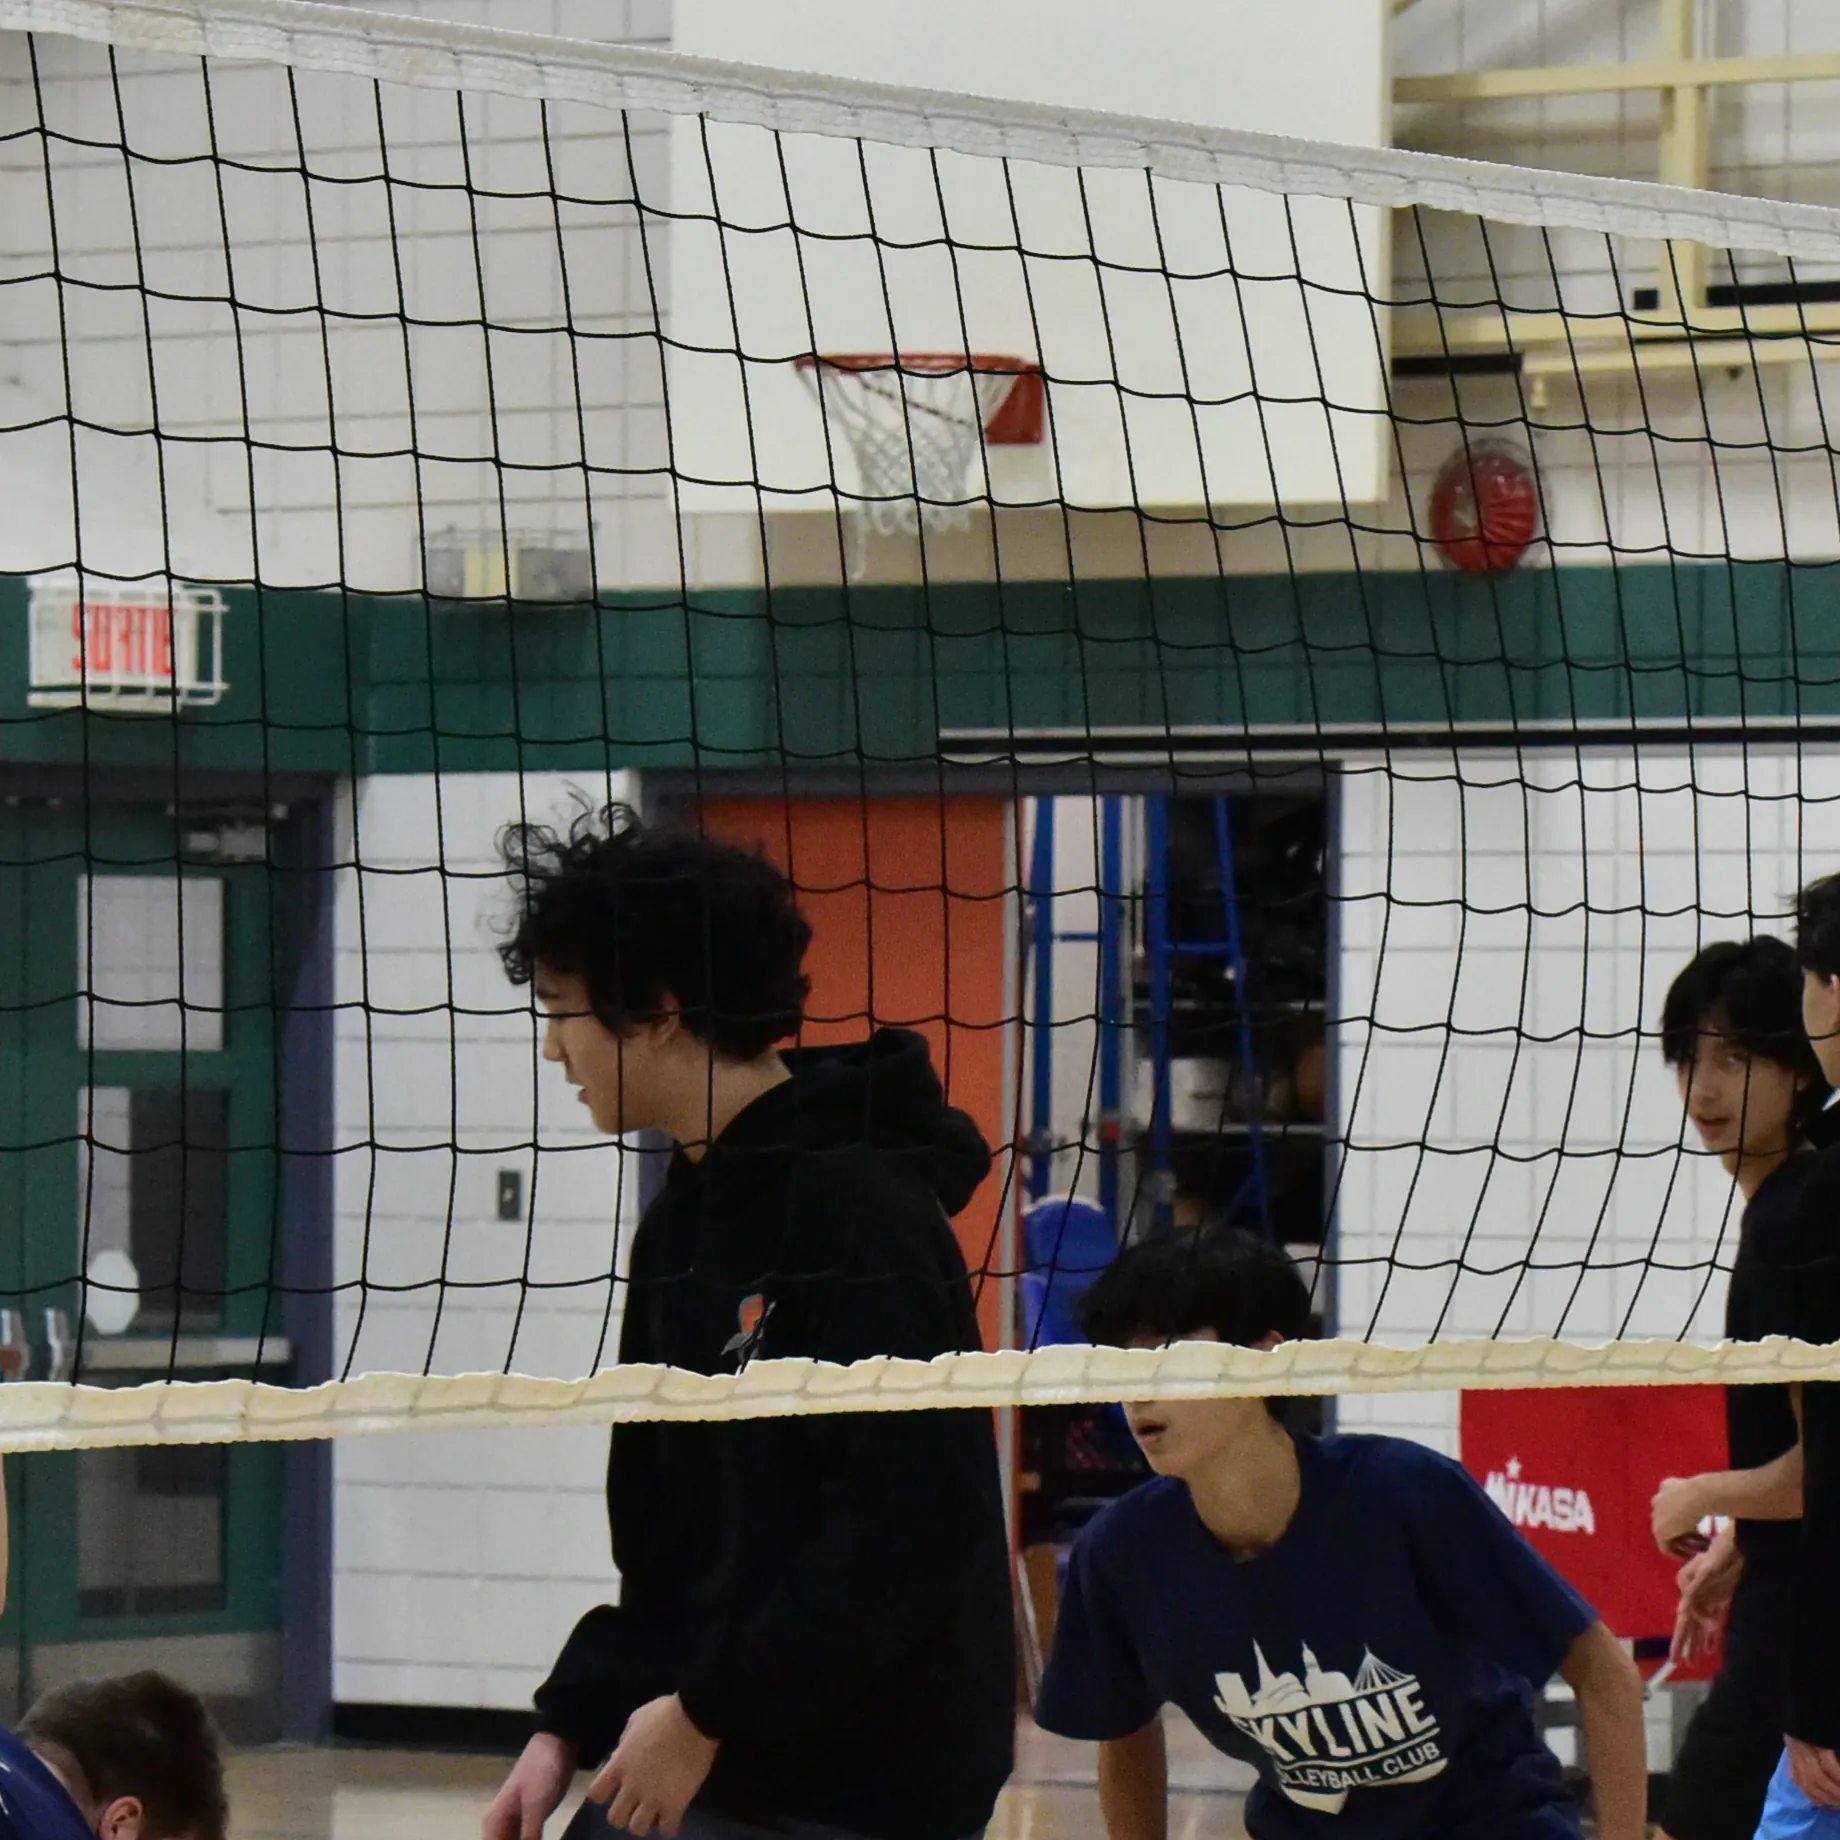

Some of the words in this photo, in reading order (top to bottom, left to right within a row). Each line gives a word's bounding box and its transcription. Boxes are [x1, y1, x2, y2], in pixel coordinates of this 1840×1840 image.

[1232, 1681, 1437, 1762] KYLINE
[1280, 1764, 1382, 1790] LLEYBALL
[1382, 1741, 1441, 1776] CLUB
